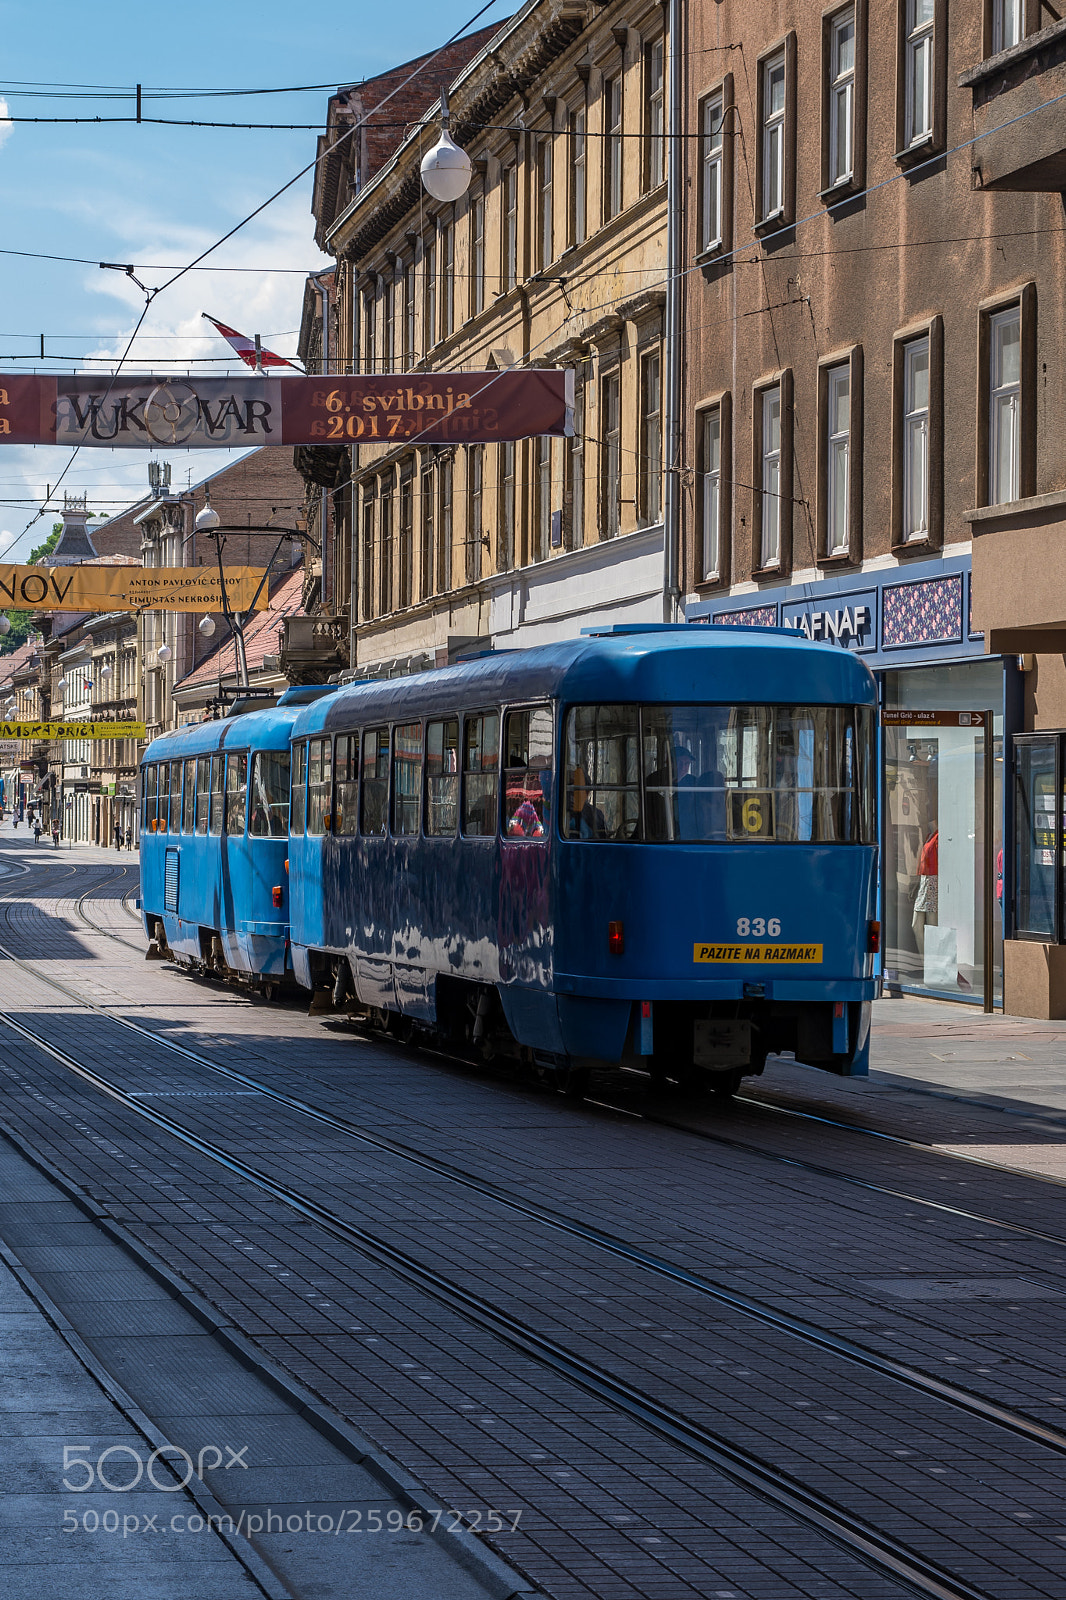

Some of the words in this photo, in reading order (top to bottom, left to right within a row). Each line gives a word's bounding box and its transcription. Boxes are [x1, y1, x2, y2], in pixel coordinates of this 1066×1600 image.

[325, 389, 351, 413] 6.
[362, 387, 473, 414] svibnja
[326, 415, 411, 439] 2017.
[129, 579, 161, 587] ANTON
[742, 798, 763, 833] 6
[736, 917, 782, 937] 836
[699, 947, 742, 960] PAZITE
[744, 947, 760, 960] NA
[764, 947, 817, 961] RAZMAK!
